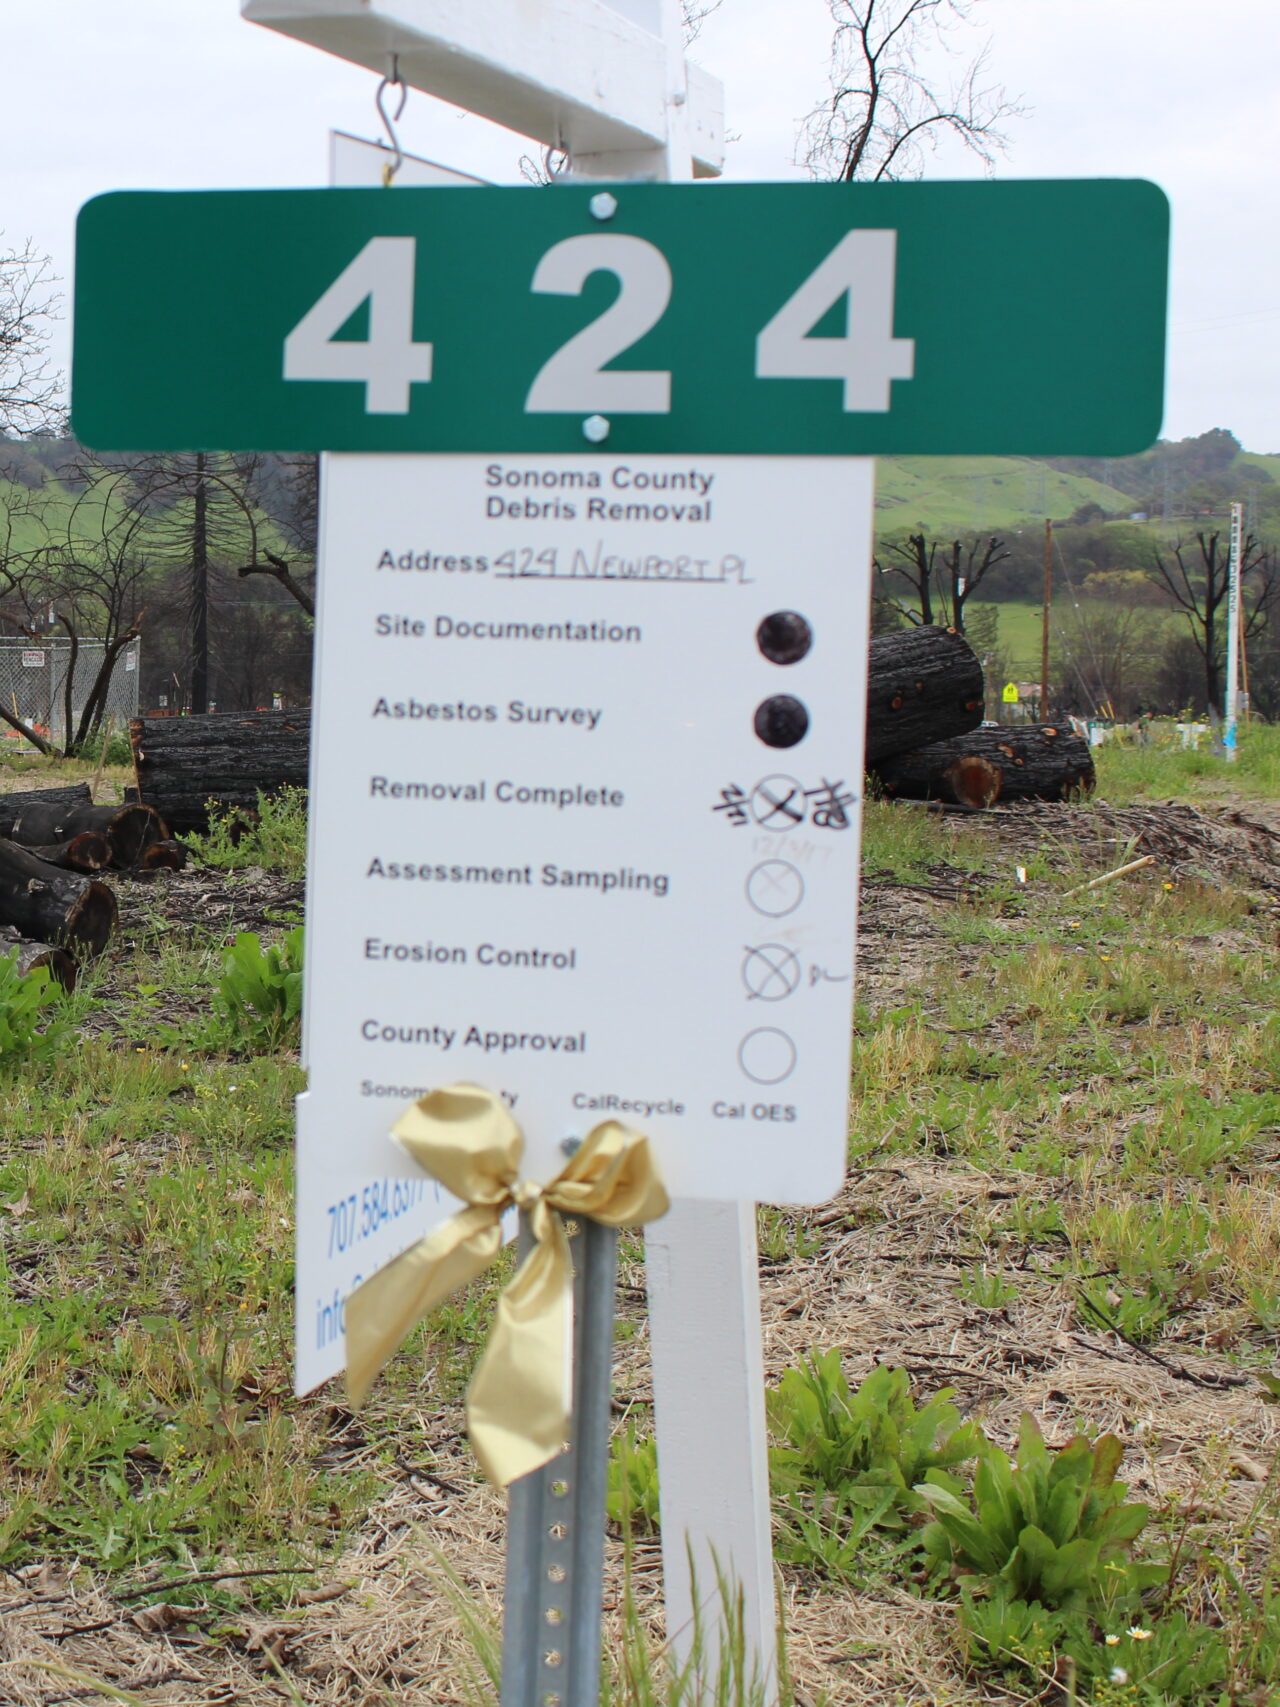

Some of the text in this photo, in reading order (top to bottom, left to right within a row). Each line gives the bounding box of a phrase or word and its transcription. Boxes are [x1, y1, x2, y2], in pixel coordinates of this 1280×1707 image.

[282, 228, 915, 416] 424
[486, 464, 714, 494] Sonoma County
[486, 496, 712, 522] Debris Removal
[376, 550, 488, 573] Address
[376, 614, 642, 643] Site Documentation
[372, 698, 602, 730] Asbestos Survey
[369, 776, 625, 809] Removal Complete
[366, 858, 670, 897] Assessment Sampling
[364, 938, 577, 970] Erosion Control
[360, 1018, 586, 1054] County Approval
[361, 1079, 429, 1099] Sonom
[572, 1093, 797, 1123] CalRecycle Cal OES
